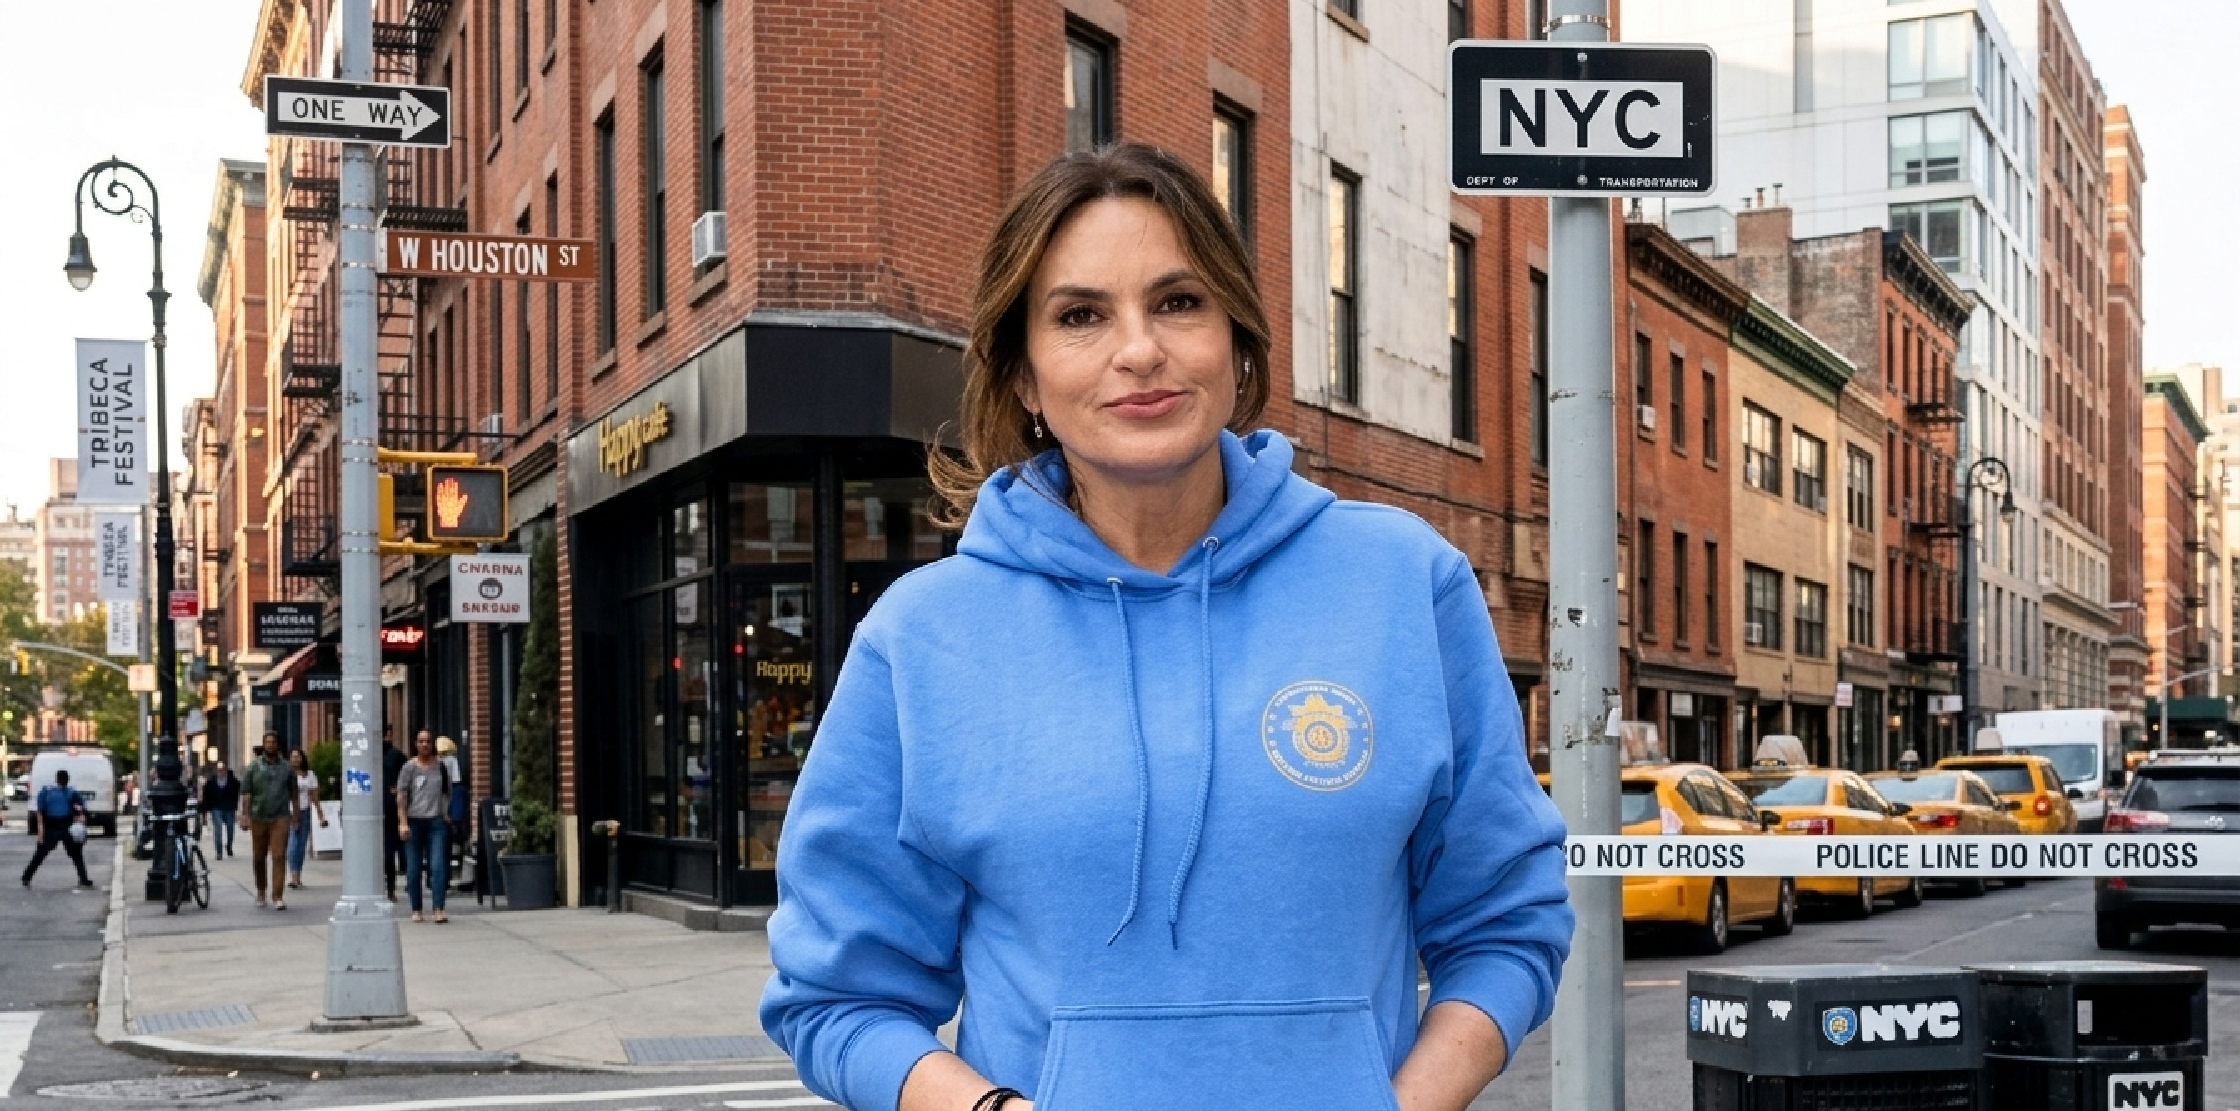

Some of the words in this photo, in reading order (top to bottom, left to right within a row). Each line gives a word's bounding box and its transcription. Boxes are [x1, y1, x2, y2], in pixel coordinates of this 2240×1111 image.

[292, 97, 345, 121] ONE
[368, 102, 422, 127] WAY
[1500, 88, 1661, 150] NYC
[398, 237, 420, 269] W
[431, 238, 548, 276] HOUSTON
[559, 244, 580, 266] ST
[90, 357, 110, 468] TRIBECA
[113, 363, 134, 486] FESTIVAL
[598, 415, 642, 478] Happy
[756, 661, 813, 685] Happy
[1565, 843, 1586, 869] O
[1597, 843, 1648, 869] NOT
[1658, 843, 1745, 869] CROSS
[1816, 842, 1909, 869] POLICE
[1921, 842, 1979, 869] LINE
[1991, 842, 2028, 869] DO
[2039, 842, 2093, 869] NOT
[2104, 842, 2199, 869] CROSS
[1701, 999, 1748, 1039] NYC
[1861, 1000, 1961, 1042] NYC
[2114, 1080, 2181, 1109] NYC
